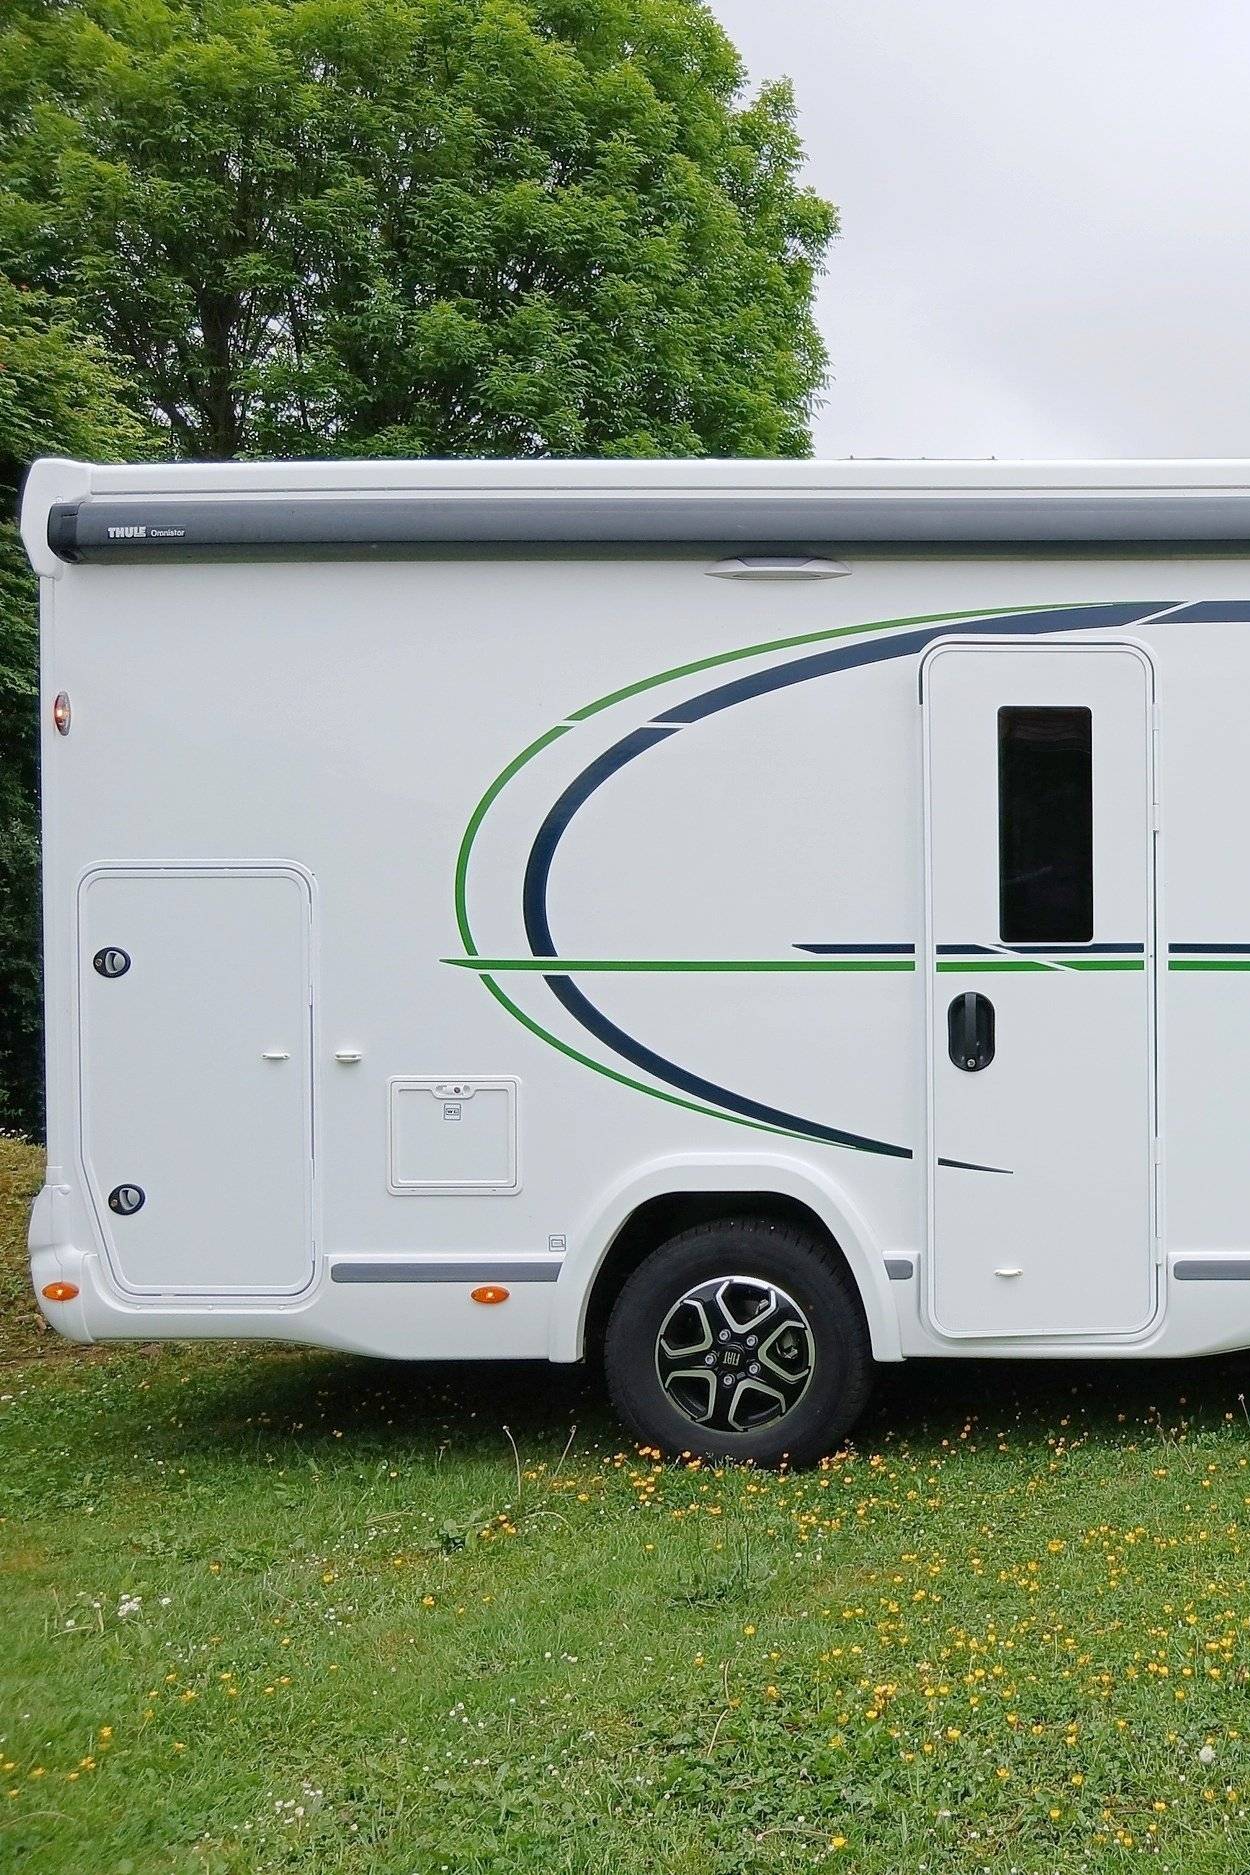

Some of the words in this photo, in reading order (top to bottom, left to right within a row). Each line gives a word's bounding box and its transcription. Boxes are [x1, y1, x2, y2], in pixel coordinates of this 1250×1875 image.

[107, 526, 147, 538] THULE
[150, 528, 185, 537] Omnistor
[722, 1351, 741, 1367] FIAT
